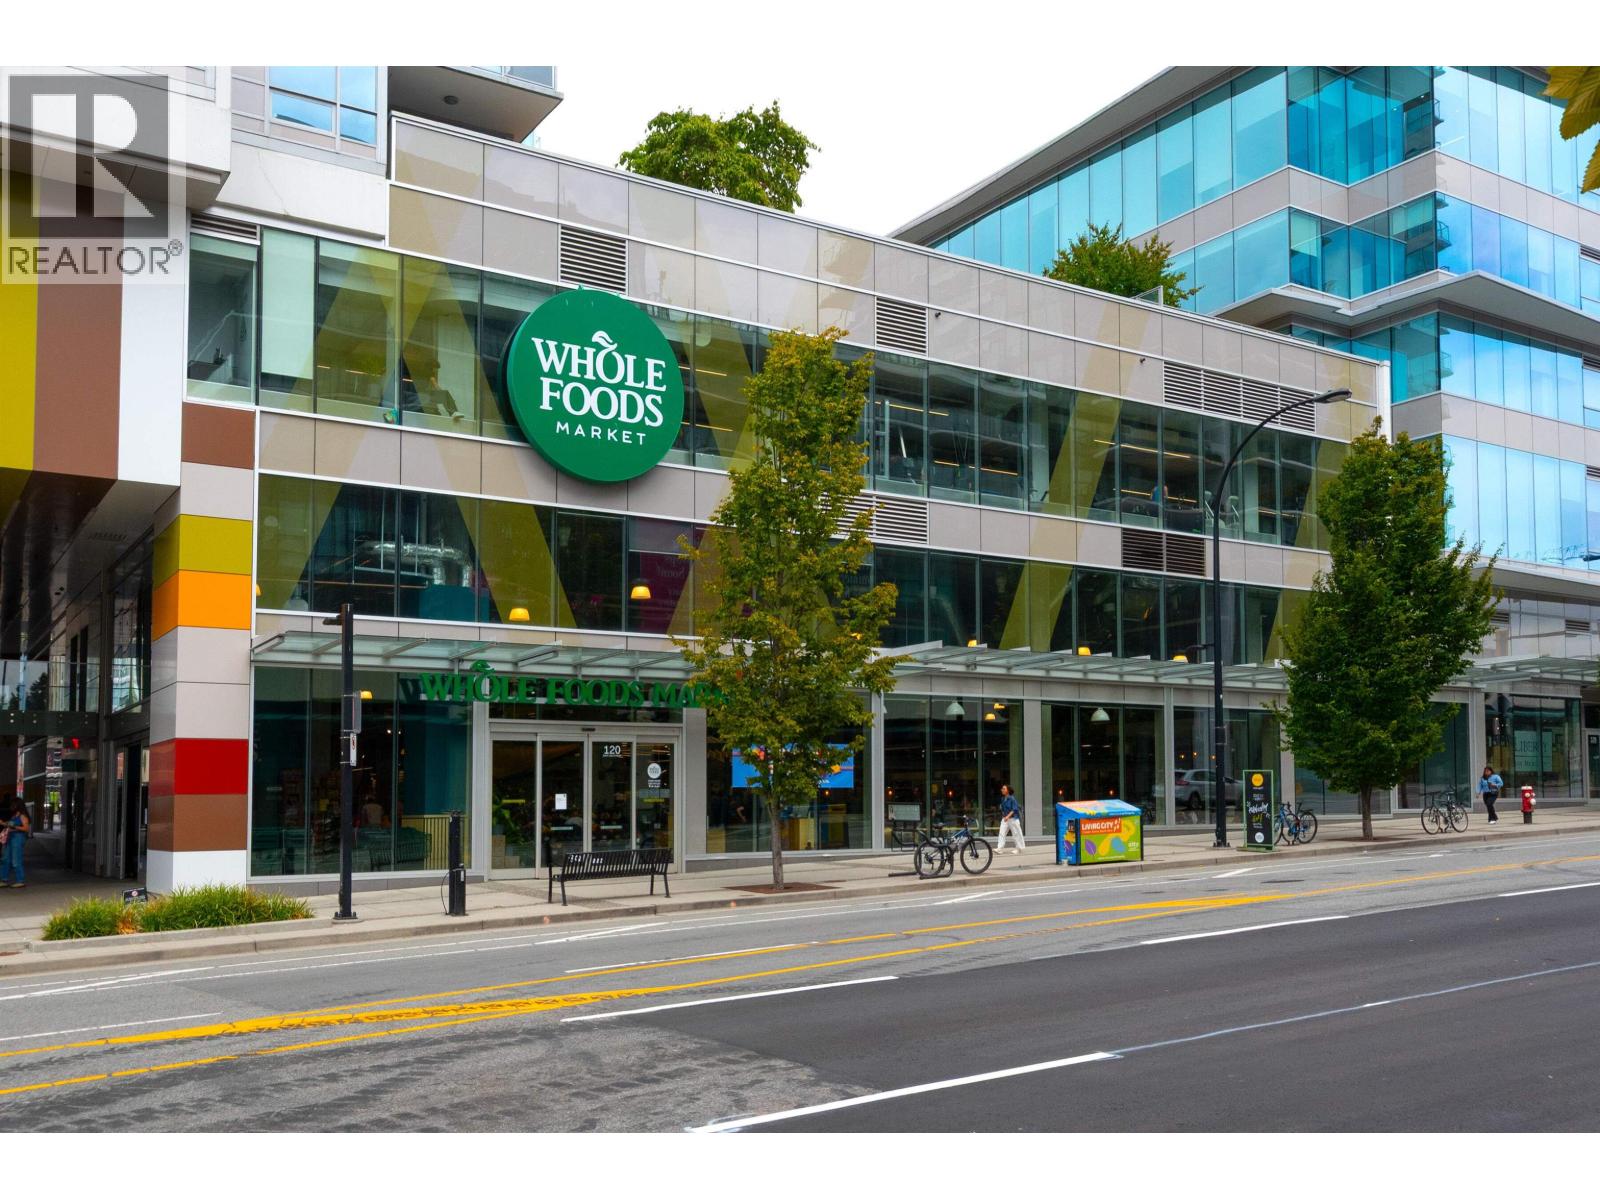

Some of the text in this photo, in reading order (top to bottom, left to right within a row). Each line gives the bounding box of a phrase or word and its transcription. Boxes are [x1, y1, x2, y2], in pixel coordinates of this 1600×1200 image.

[531, 335, 667, 392] WHOLE
[539, 376, 664, 428] FOODS
[556, 421, 646, 445] MARKET
[420, 671, 538, 703] WHOLE
[545, 677, 645, 707] FOODS
[603, 745, 621, 755] 120
[1081, 822, 1101, 831] LIVING
[1101, 821, 1114, 830] CITY
